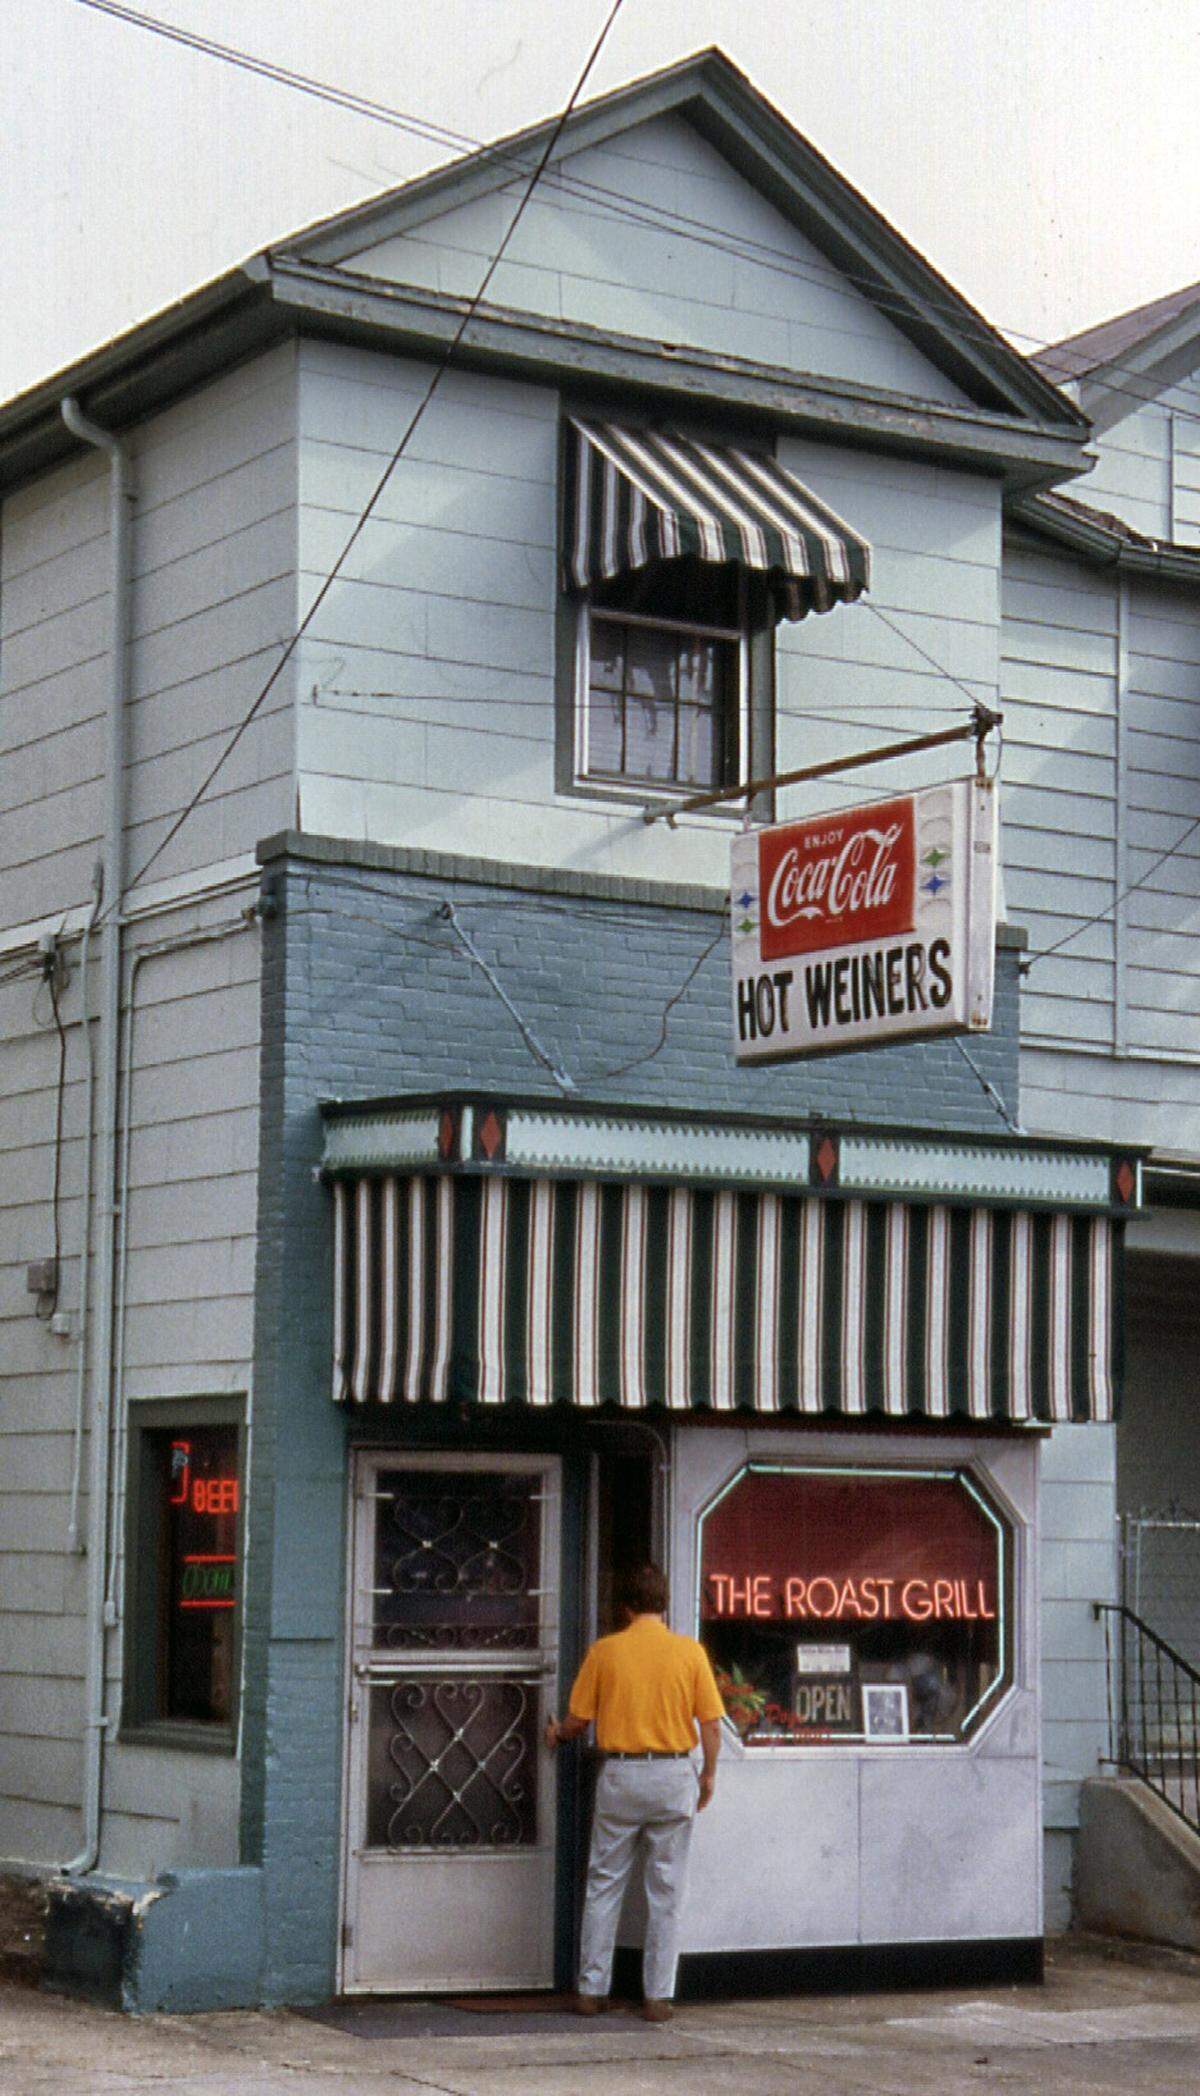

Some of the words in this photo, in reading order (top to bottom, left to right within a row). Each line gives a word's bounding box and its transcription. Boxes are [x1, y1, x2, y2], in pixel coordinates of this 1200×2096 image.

[804, 828, 844, 849] ENJOY
[767, 823, 903, 927] Coca-Cola
[737, 970, 793, 1041] HOT
[805, 937, 952, 1030] WEINERS
[709, 1573, 772, 1616] THE
[785, 1576, 894, 1619] ROAST
[901, 1579, 995, 1620] GRILL
[796, 1684, 850, 1722] OPEN
